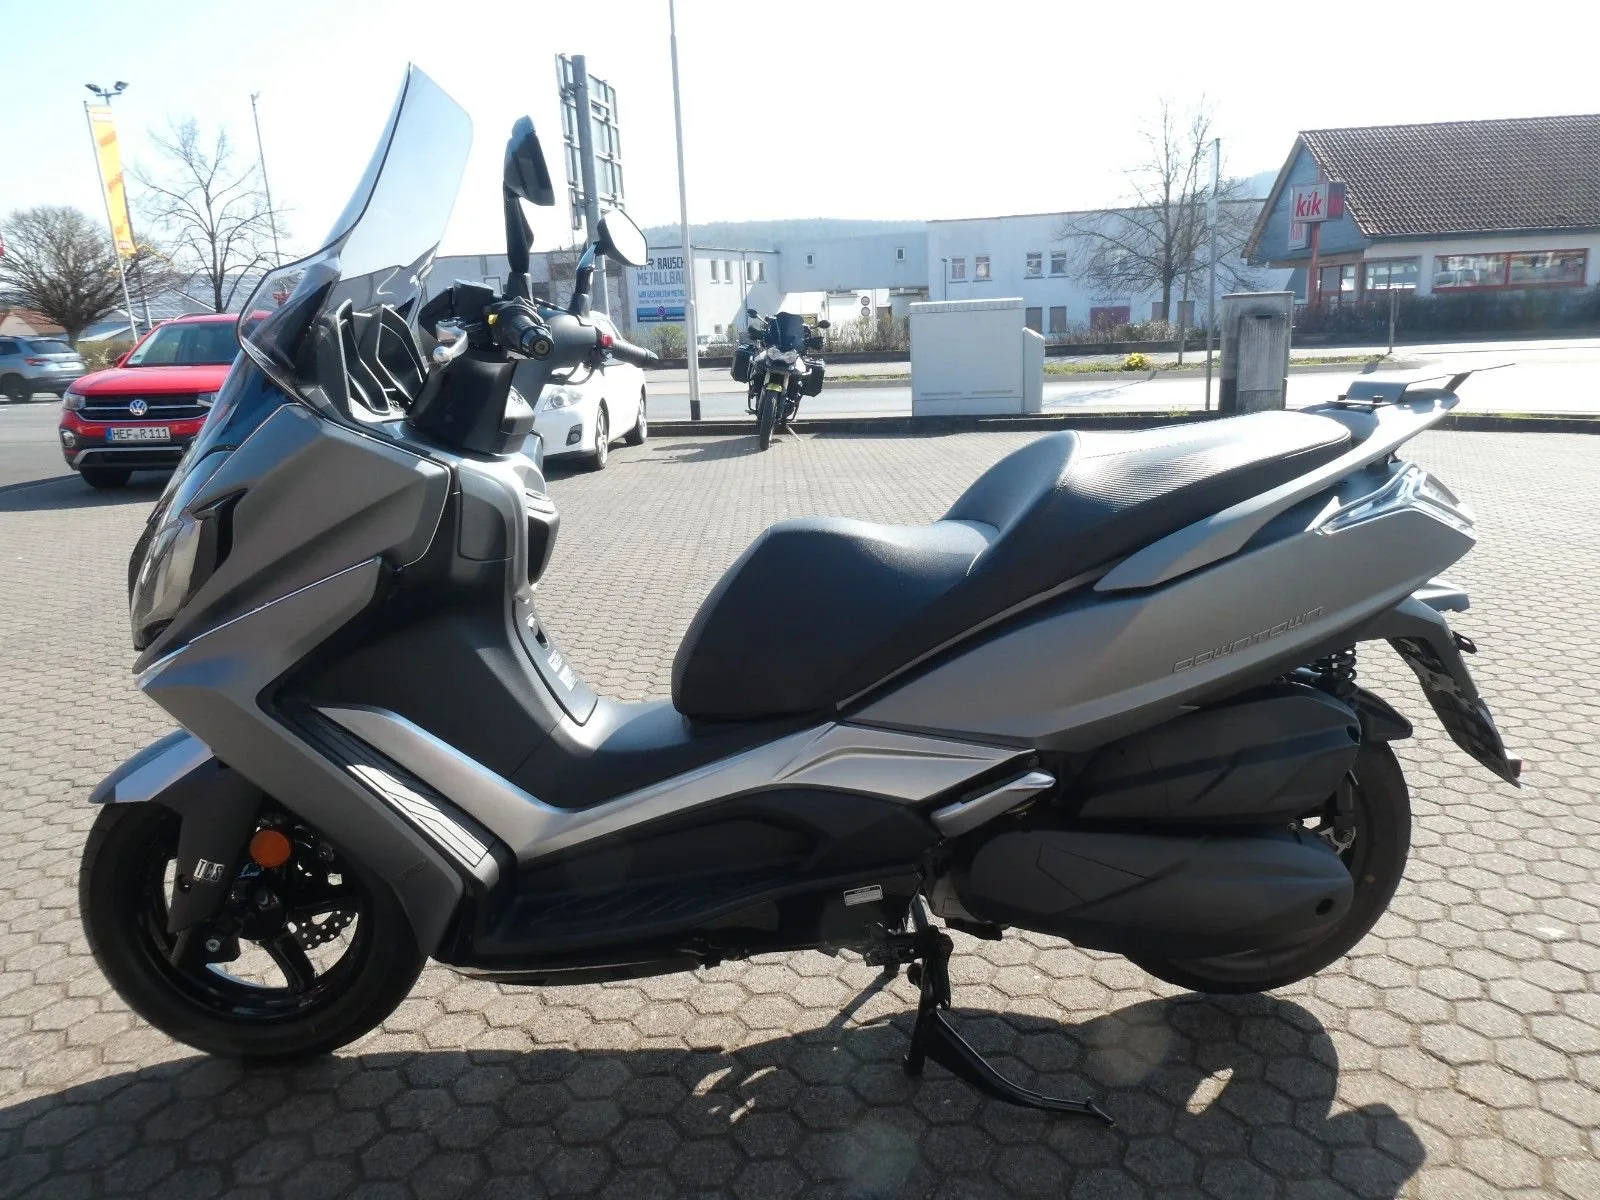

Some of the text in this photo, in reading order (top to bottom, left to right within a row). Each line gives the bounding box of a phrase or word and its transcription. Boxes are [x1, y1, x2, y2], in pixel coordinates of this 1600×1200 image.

[112, 428, 169, 440] HEF R 111
[1172, 605, 1324, 674] DOWNTOWN
[193, 858, 225, 881] TCS
